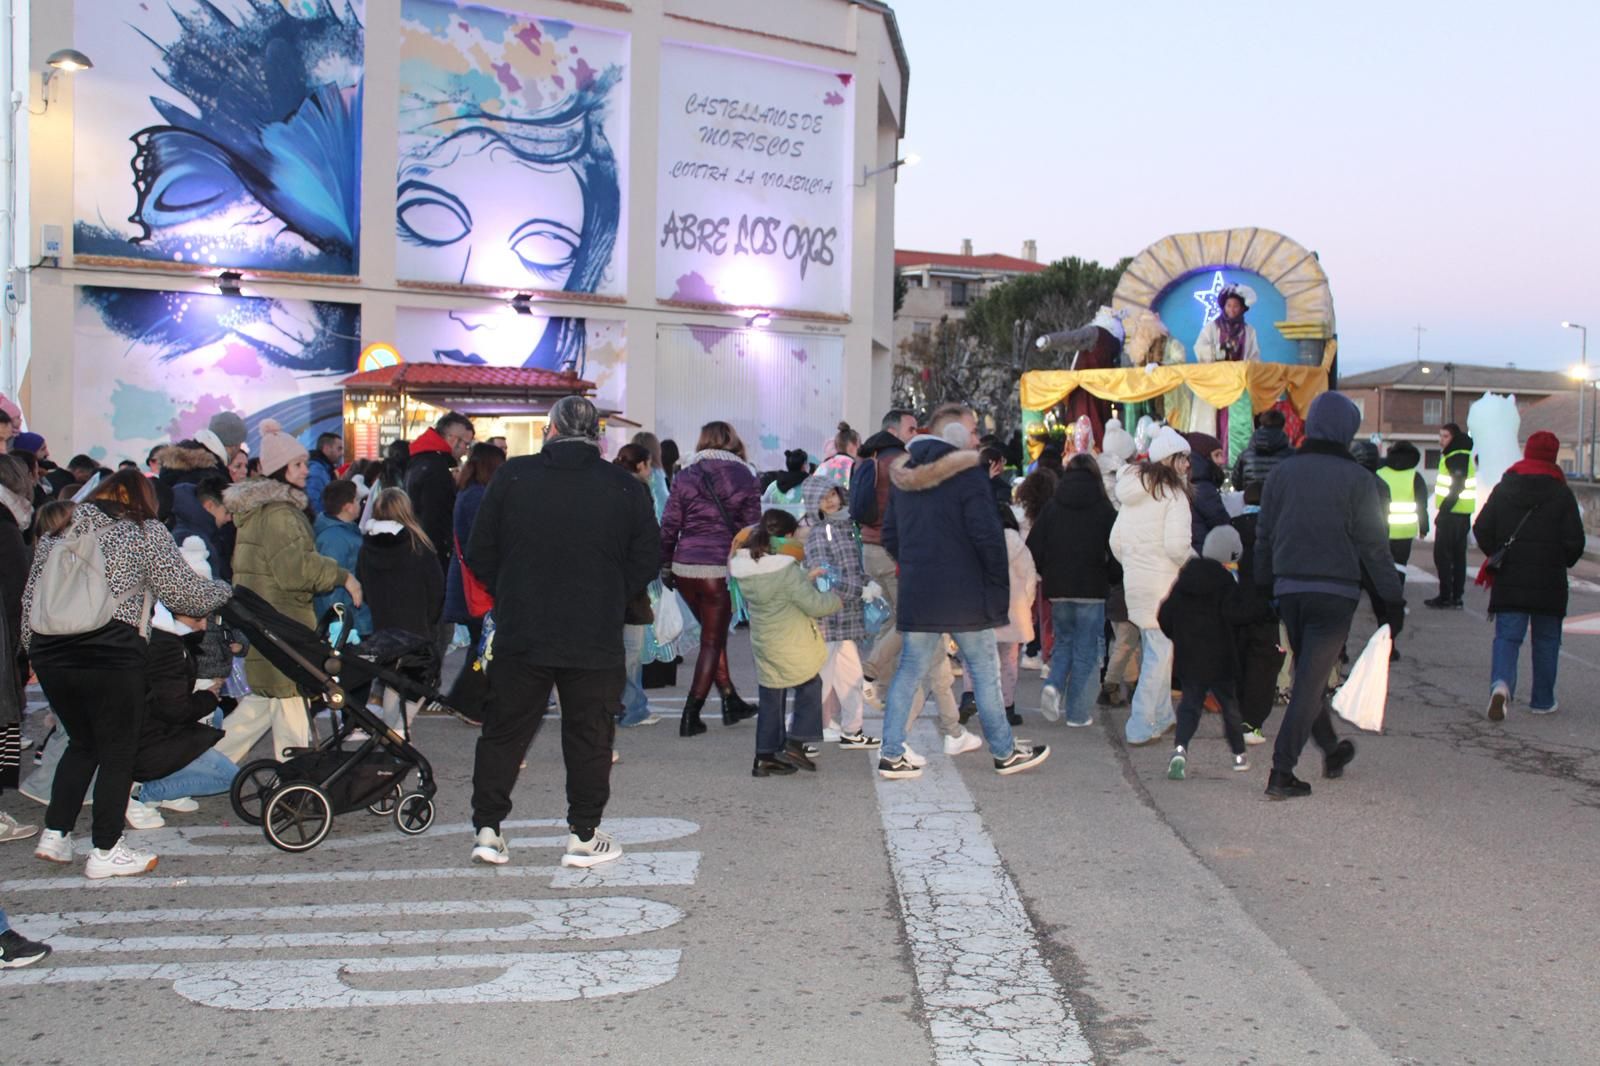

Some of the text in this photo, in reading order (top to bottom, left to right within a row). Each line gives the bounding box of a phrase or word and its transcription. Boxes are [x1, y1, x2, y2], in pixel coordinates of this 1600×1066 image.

[685, 93, 823, 134] CASTELLANOS DE
[699, 126, 805, 157] MORISCOS
[672, 161, 833, 194] CONTRA LA VIOLENCIA
[661, 210, 838, 281] ABRE LOS OJOS
